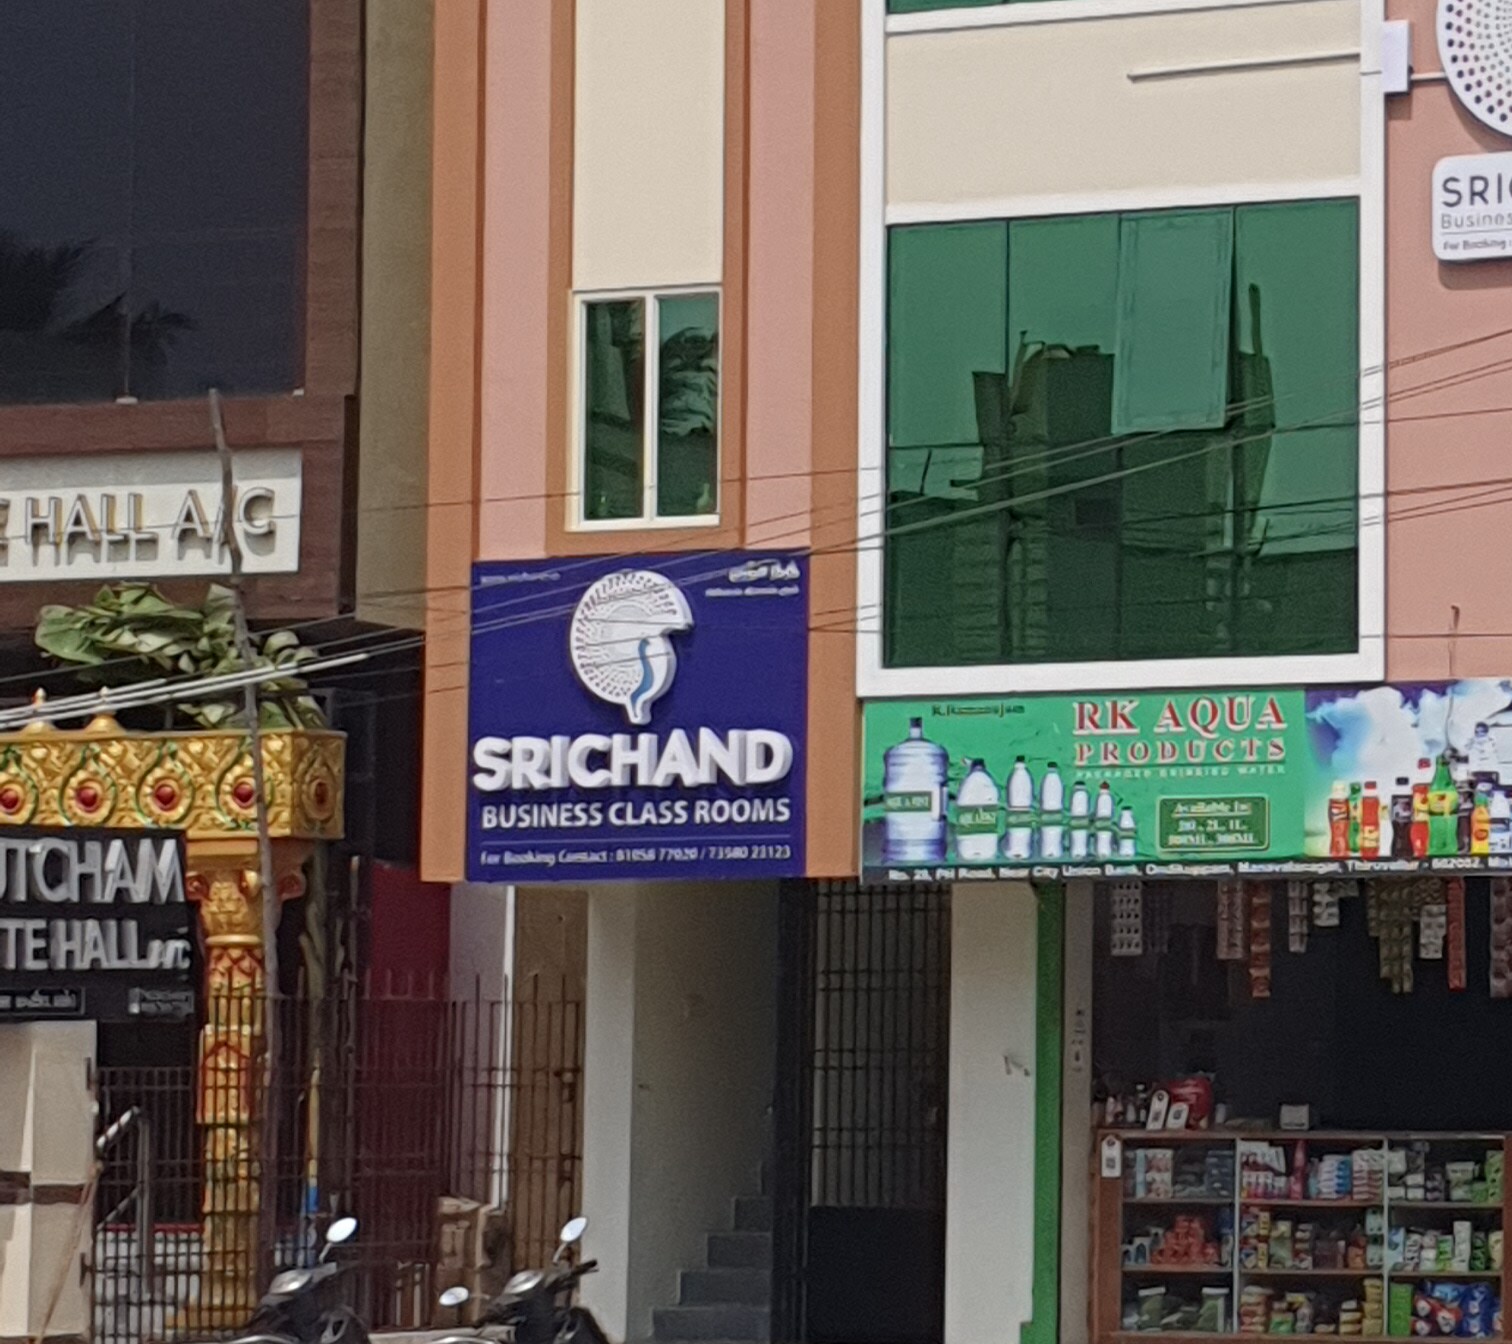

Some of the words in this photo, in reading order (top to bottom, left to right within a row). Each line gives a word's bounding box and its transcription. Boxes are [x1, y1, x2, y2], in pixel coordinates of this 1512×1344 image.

[25, 492, 159, 548] HALL
[1073, 700, 1140, 735] RK
[1153, 694, 1288, 739] AQUA
[473, 726, 794, 791] SRICHAND
[1074, 736, 1286, 766] PRODUCTS
[1238, 765, 1286, 775] WATER
[481, 802, 602, 830] BUSINESS
[608, 799, 688, 826] CLASS
[694, 797, 791, 824] ROOMS
[1032, 866, 1059, 880] City
[51, 917, 151, 970] HALL
